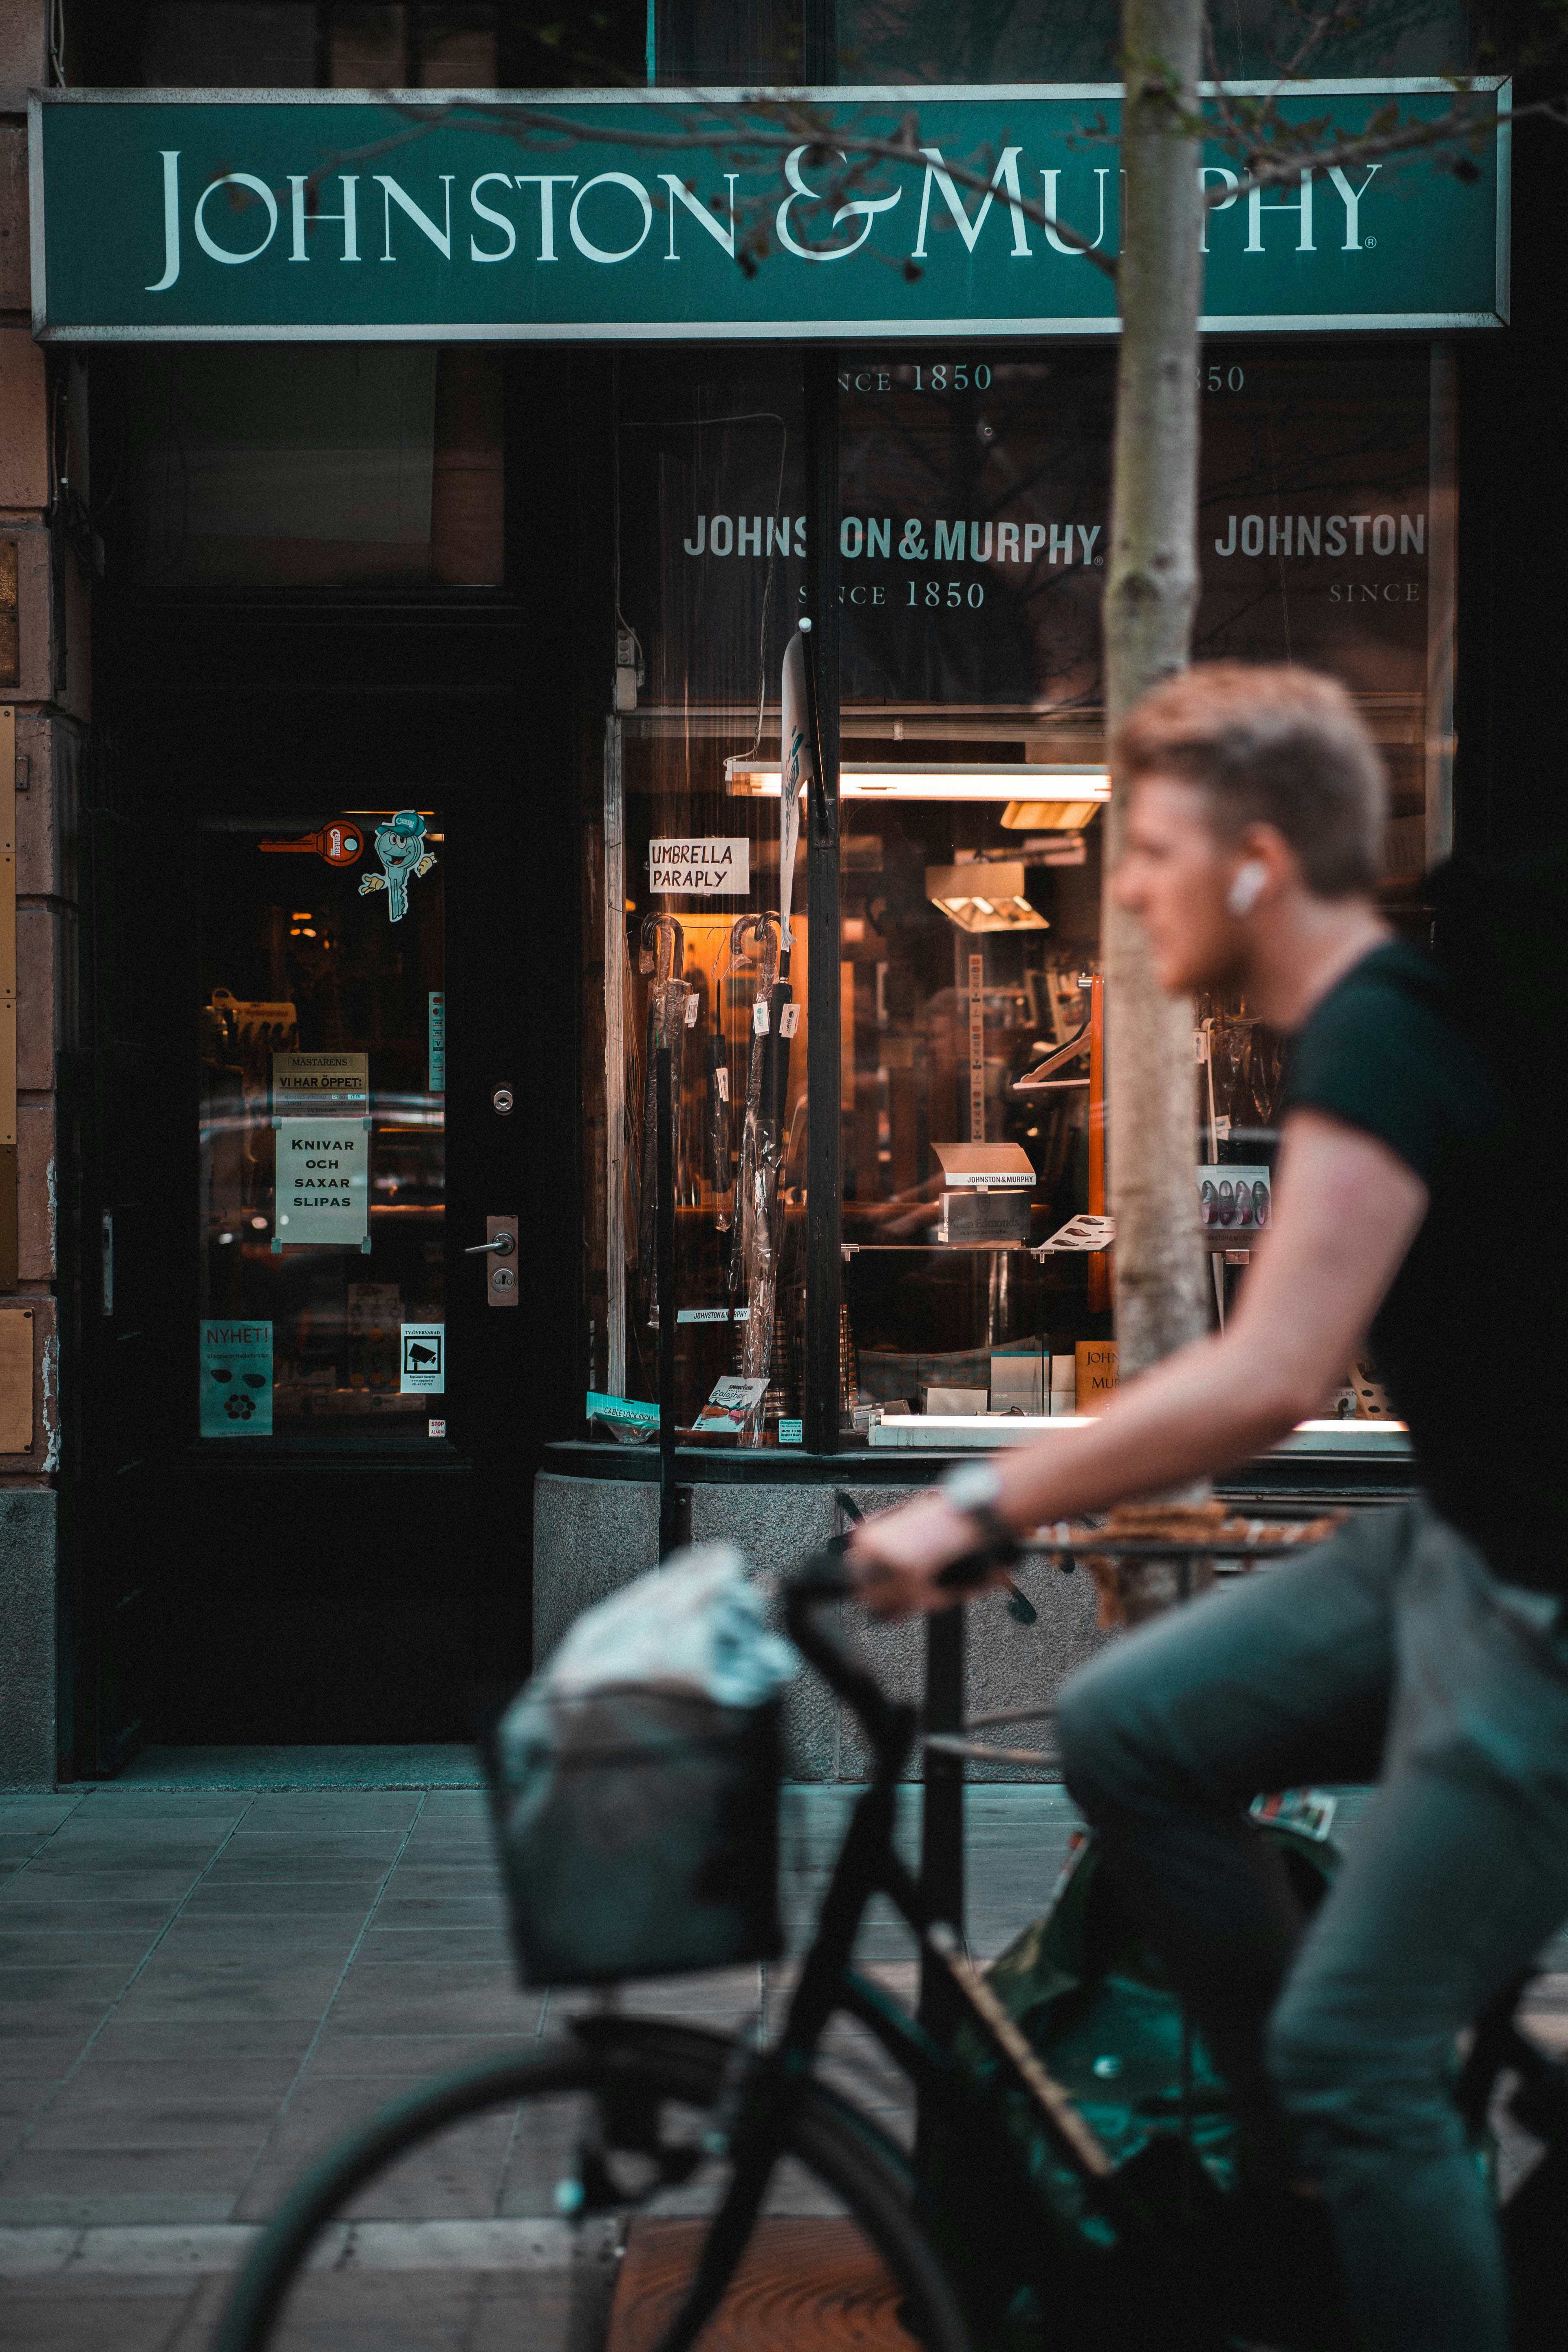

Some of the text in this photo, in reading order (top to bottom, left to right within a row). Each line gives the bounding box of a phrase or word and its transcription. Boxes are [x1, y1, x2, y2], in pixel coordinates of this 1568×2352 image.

[145, 143, 1383, 291] JOHNSTON & MUPHY
[837, 364, 992, 391] NCE 1850
[1215, 514, 1425, 557] JOHNSTON
[906, 580, 984, 609] 1850
[1329, 583, 1420, 603] SINCE
[652, 845, 732, 865] UMBRELLA
[653, 870, 728, 887] PARAPLY
[280, 1075, 362, 1087] VI HAR ÖPPET:
[291, 1139, 354, 1150] KNIVAR
[306, 1160, 339, 1169] OCH
[294, 1179, 350, 1188] SAXAR
[293, 1197, 351, 1207] SLIPAS
[951, 1219, 973, 1229] Allen
[976, 1216, 1020, 1228] Edmonds
[694, 1311, 747, 1319] JOHNSTON&MRPHY
[207, 1327, 268, 1344] NYHET!
[712, 1389, 748, 1399] Galosher
[604, 1407, 622, 1416] CABLE
[623, 1410, 637, 1419] LOCK
